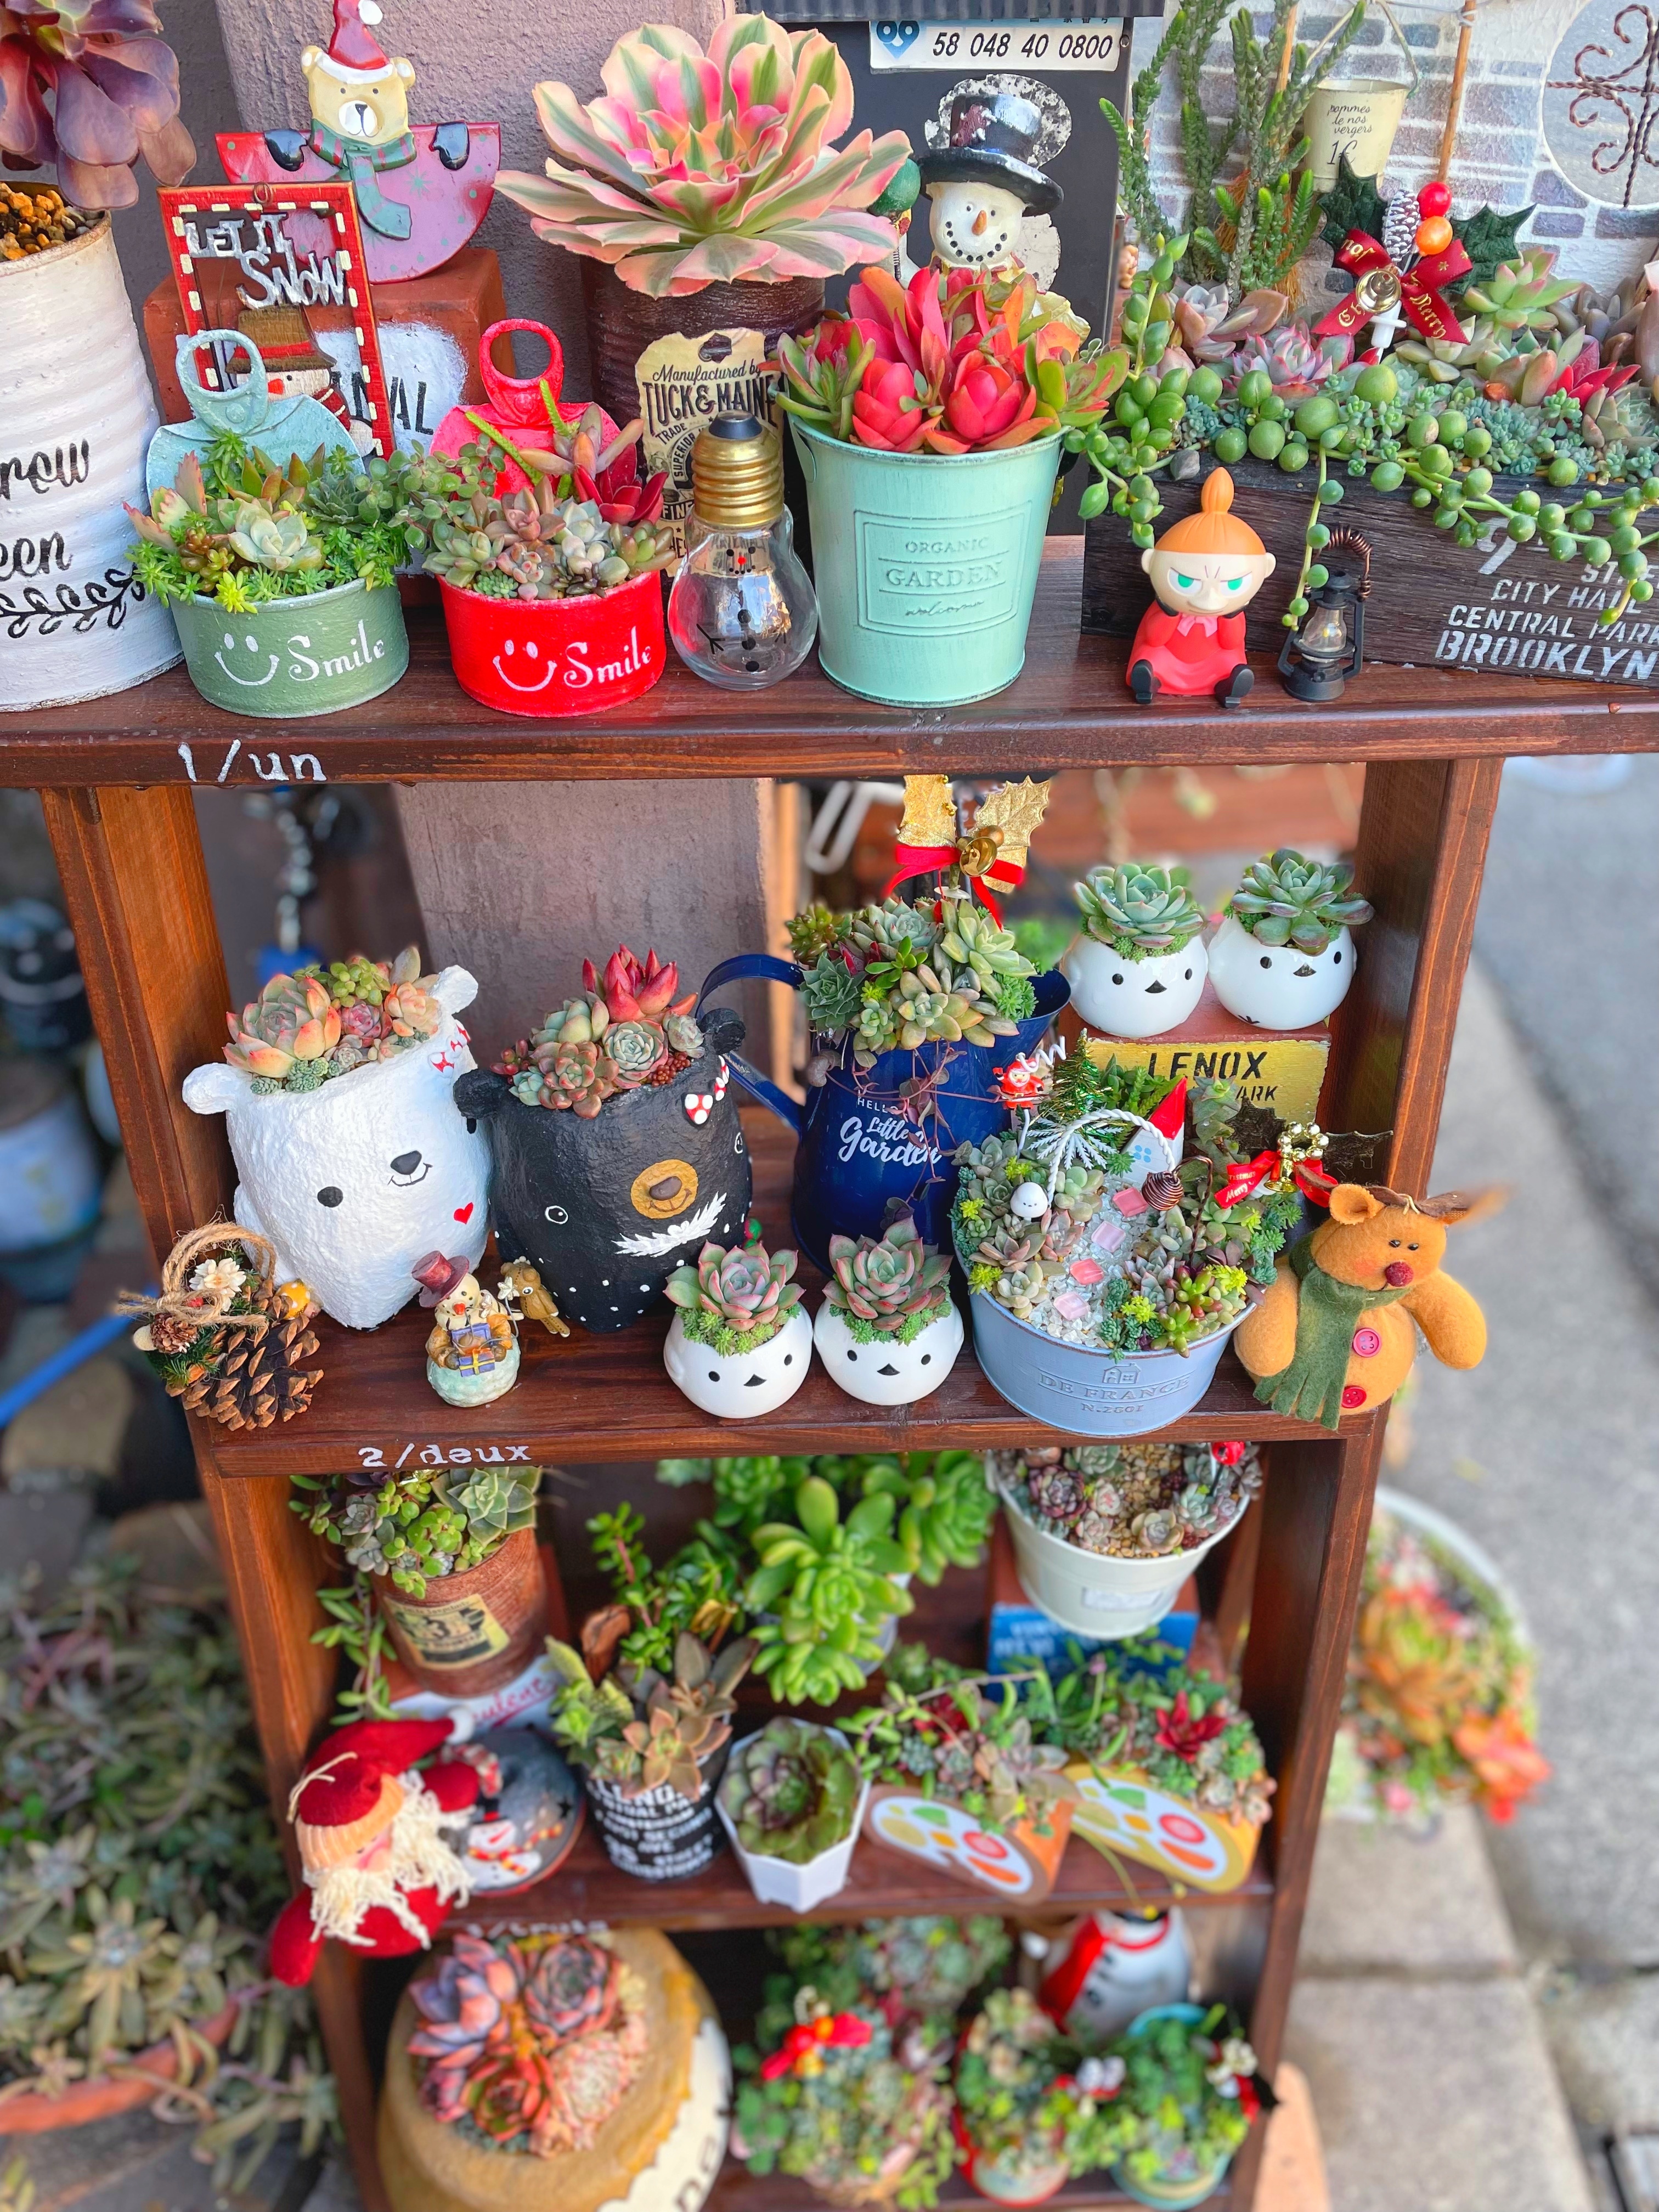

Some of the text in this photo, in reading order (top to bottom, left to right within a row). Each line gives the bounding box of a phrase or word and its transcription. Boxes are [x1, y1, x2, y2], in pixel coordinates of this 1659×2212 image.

[933, 32, 1113, 59] 58 048 40 0800
[1334, 125, 1373, 138] vergers
[1347, 116, 1367, 124] nos
[652, 359, 747, 385] Manufactured
[655, 422, 688, 445] TRADE
[905, 537, 989, 554] ORGANIC
[886, 560, 1002, 588] GARDEN
[1491, 579, 1642, 614] CITY HALL
[1447, 604, 1576, 638] CENTRAL
[287, 619, 385, 681] Smile
[563, 625, 652, 689] Smile
[1435, 629, 1659, 680] BROOKLYN
[1148, 1051, 1268, 1080] LENOX
[838, 1116, 943, 1167] Garden
[866, 1116, 910, 1141] Little
[1039, 1372, 1191, 1400] DE FRANCE
[358, 1443, 532, 1469] 2/deux
